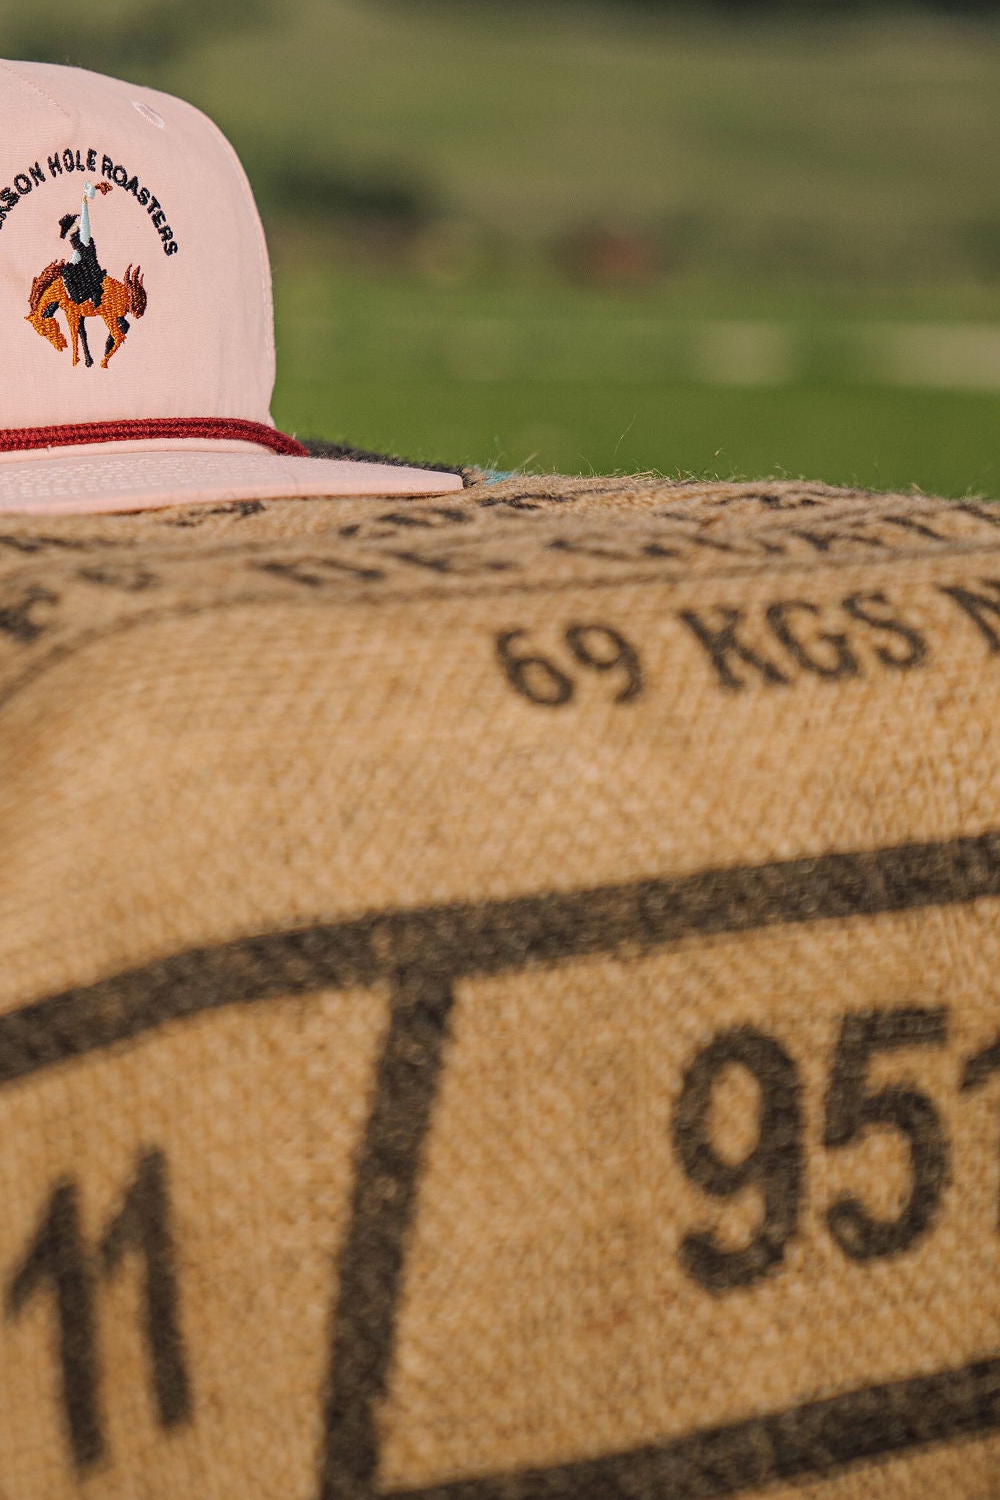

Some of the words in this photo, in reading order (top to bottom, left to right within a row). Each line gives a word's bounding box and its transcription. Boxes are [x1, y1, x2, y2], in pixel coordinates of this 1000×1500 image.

[47, 148, 98, 178] HOLE
[101, 154, 179, 257] ROASTERS
[496, 620, 645, 706] 69
[680, 589, 928, 691] KGS
[8, 1143, 194, 1479] 11
